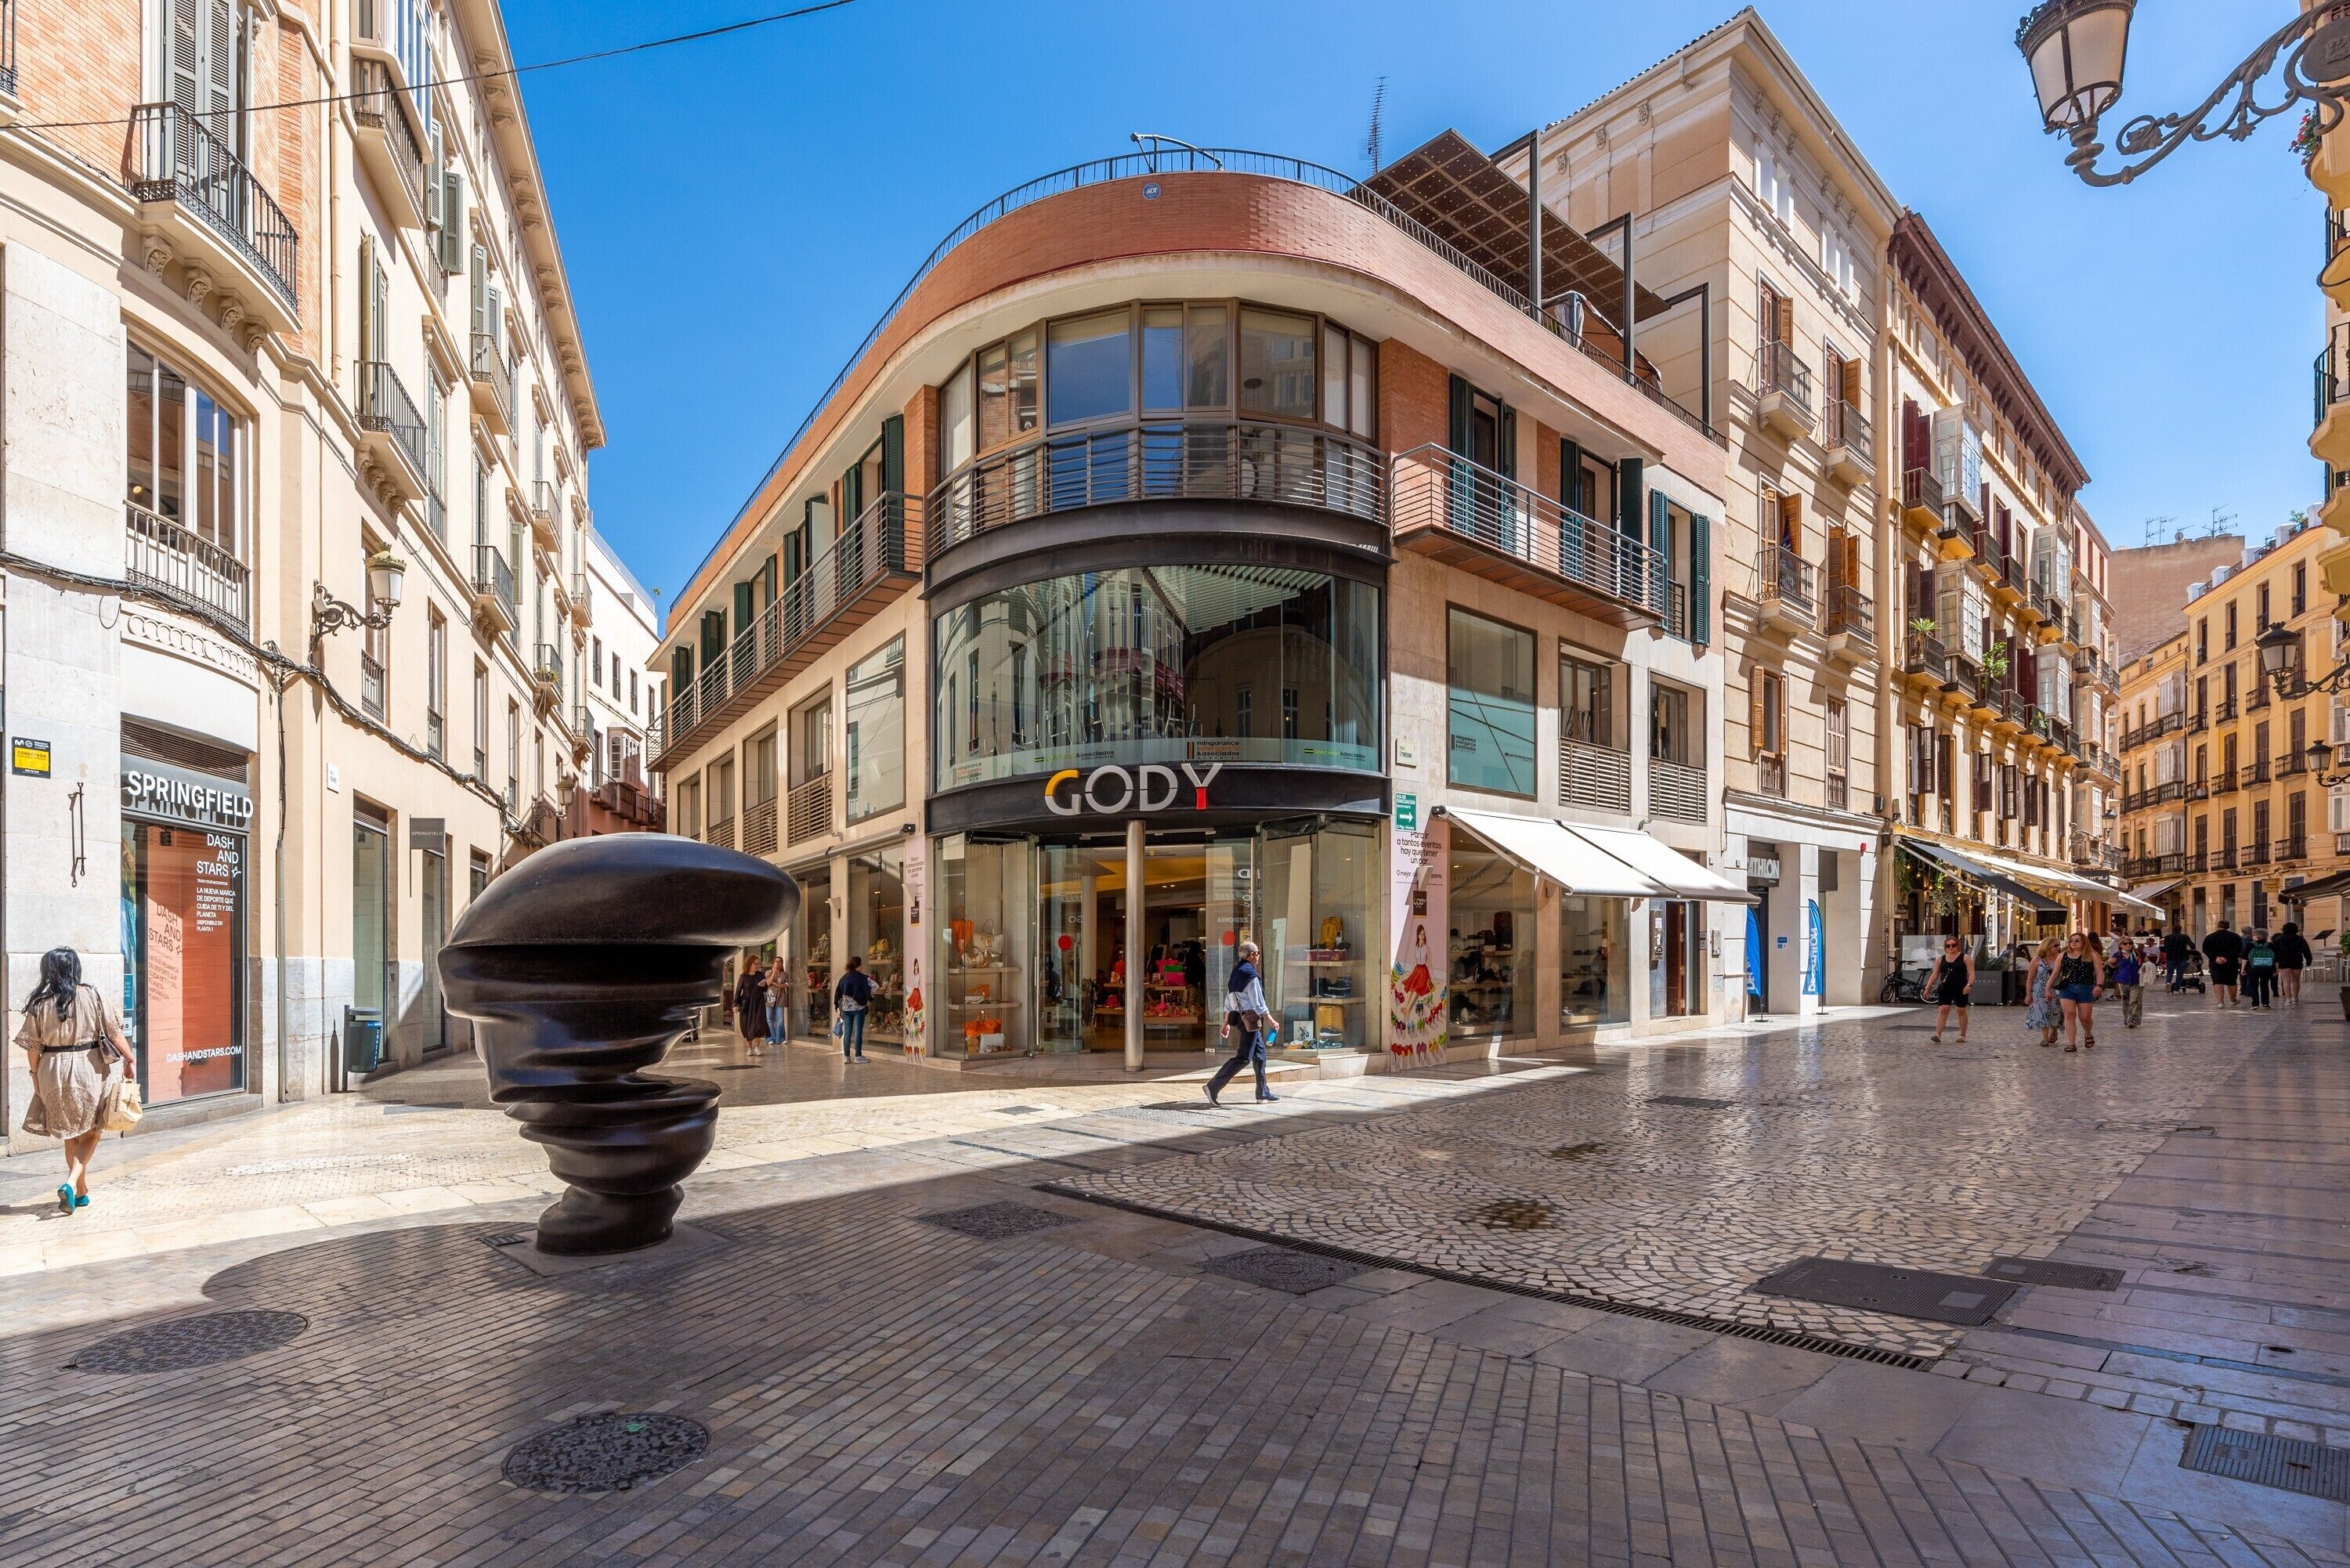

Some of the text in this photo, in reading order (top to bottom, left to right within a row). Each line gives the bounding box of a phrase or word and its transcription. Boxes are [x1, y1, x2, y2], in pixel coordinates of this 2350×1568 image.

[128, 771, 254, 818] SPRINGFIELD
[1044, 763, 1223, 816] GODY
[207, 833, 234, 850] DASH
[1401, 838, 1419, 847] tantos
[217, 850, 239, 864] AND
[1400, 847, 1438, 858] hay que tener
[197, 861, 229, 877] STARS
[1747, 857, 1780, 879] ATHLON
[157, 904, 178, 927] DASH
[149, 927, 174, 952] STARS
[164, 923, 182, 942] AND
[166, 1045, 242, 1063] DASHANDSTARS.COM
